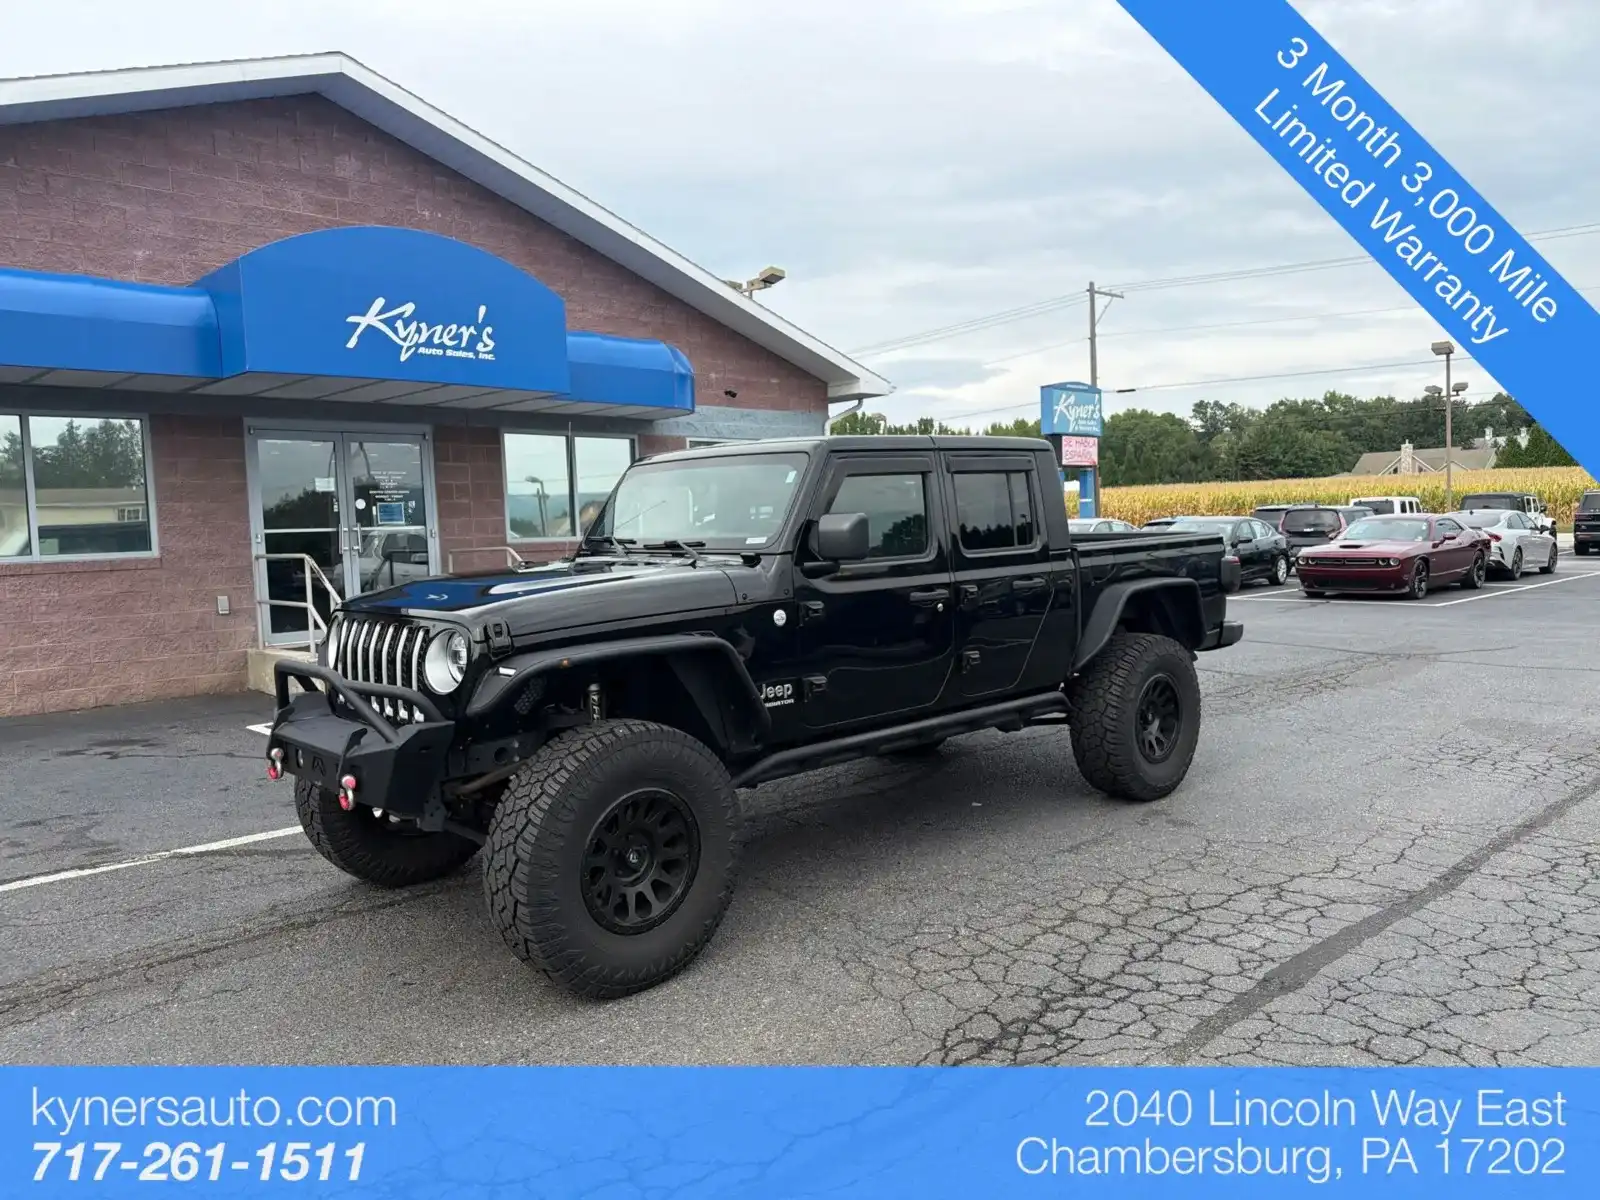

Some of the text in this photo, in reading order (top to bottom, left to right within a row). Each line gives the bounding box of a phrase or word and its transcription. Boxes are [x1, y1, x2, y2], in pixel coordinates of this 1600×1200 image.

[345, 296, 496, 362] Kyner's
[417, 346, 496, 361] Auto Sales, Inc.
[1053, 393, 1101, 432] Kyner's
[760, 683, 793, 699] Jeep
